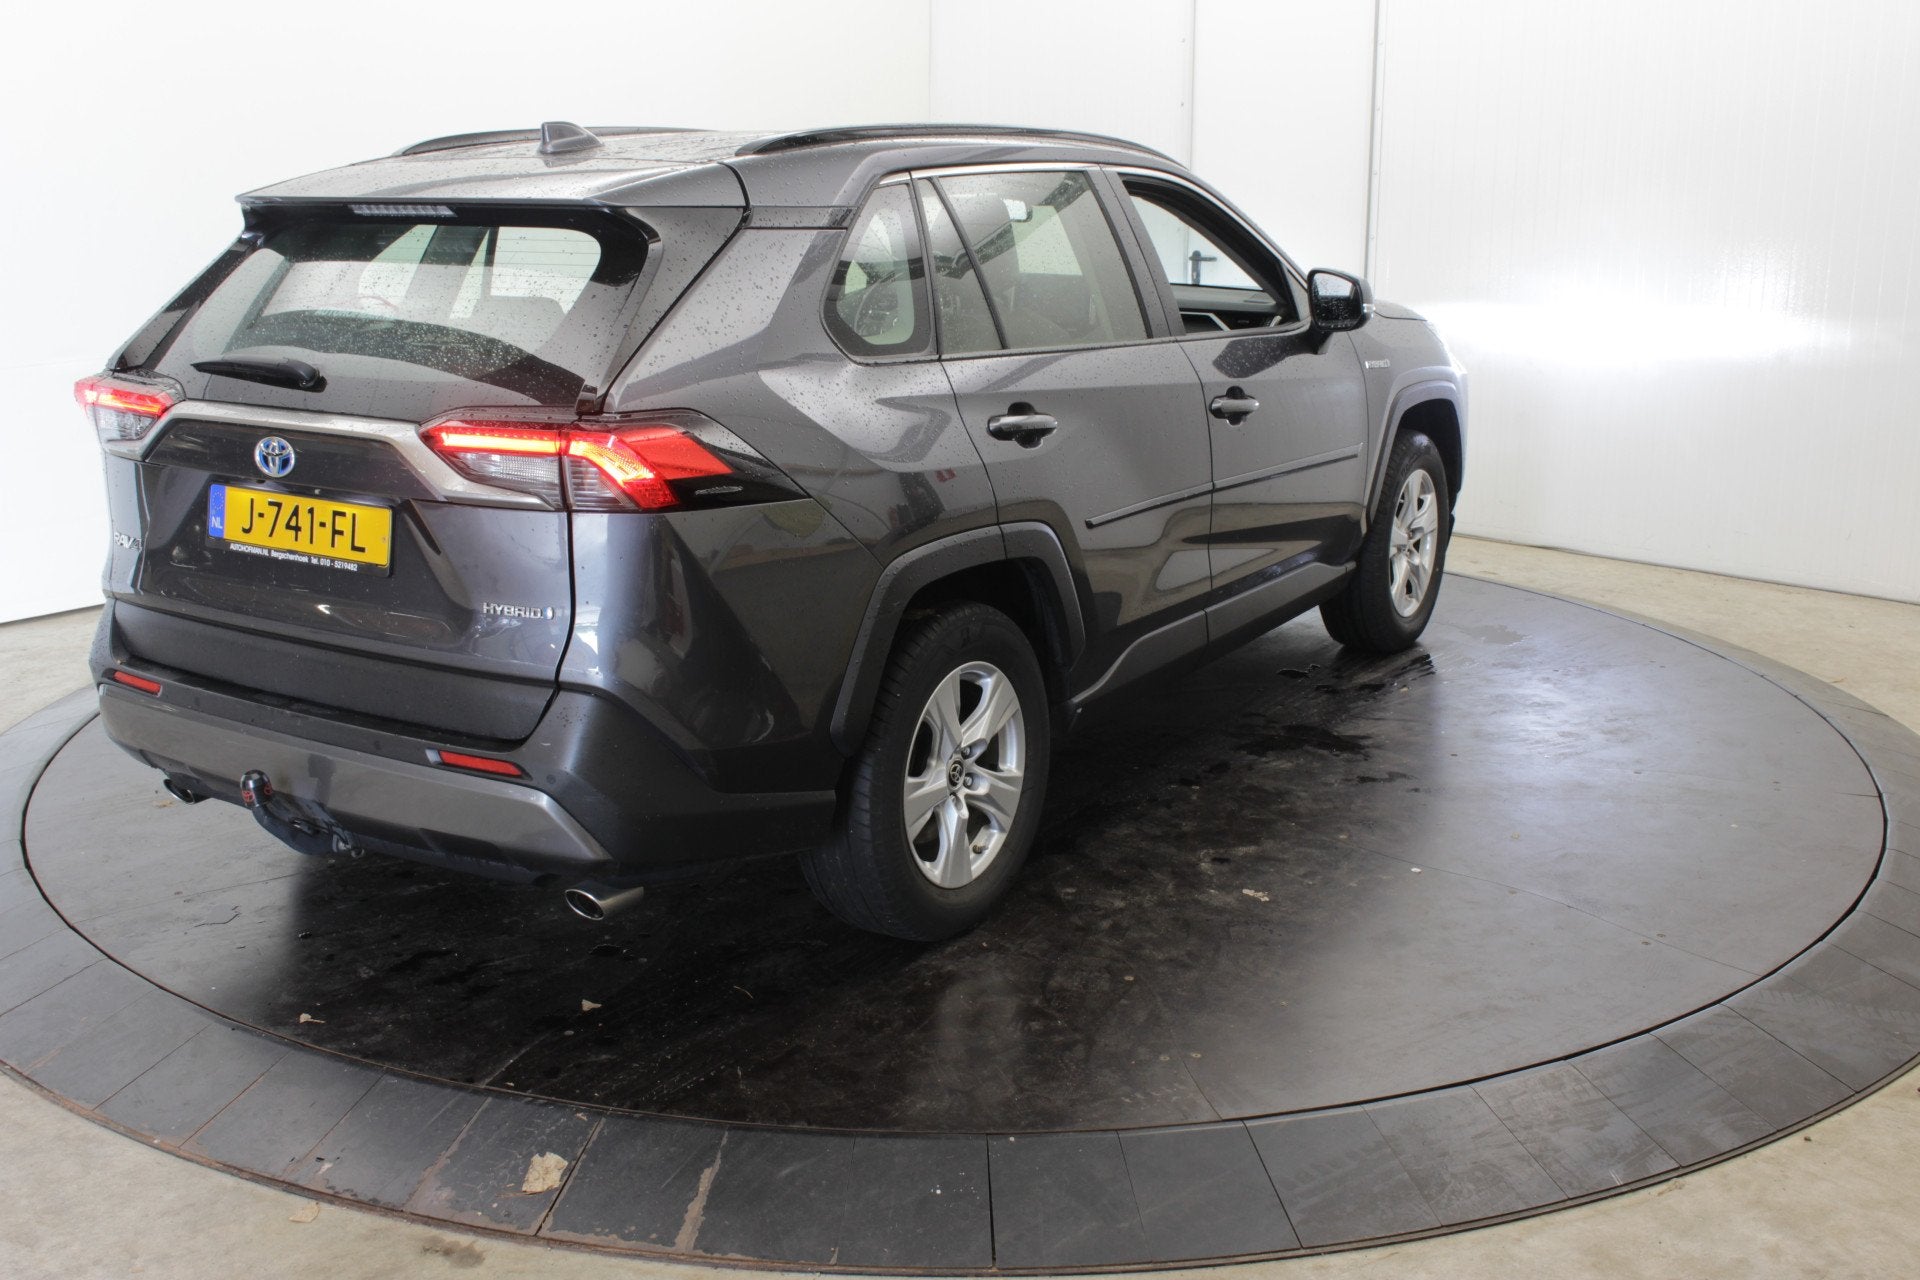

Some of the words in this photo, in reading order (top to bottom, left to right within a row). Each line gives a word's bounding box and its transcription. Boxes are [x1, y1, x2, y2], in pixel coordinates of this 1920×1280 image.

[211, 515, 223, 529] NL
[242, 497, 366, 553] J-741-FL
[114, 532, 142, 552] RAV4
[320, 558, 330, 567] 010
[483, 602, 541, 619] HYBRID
